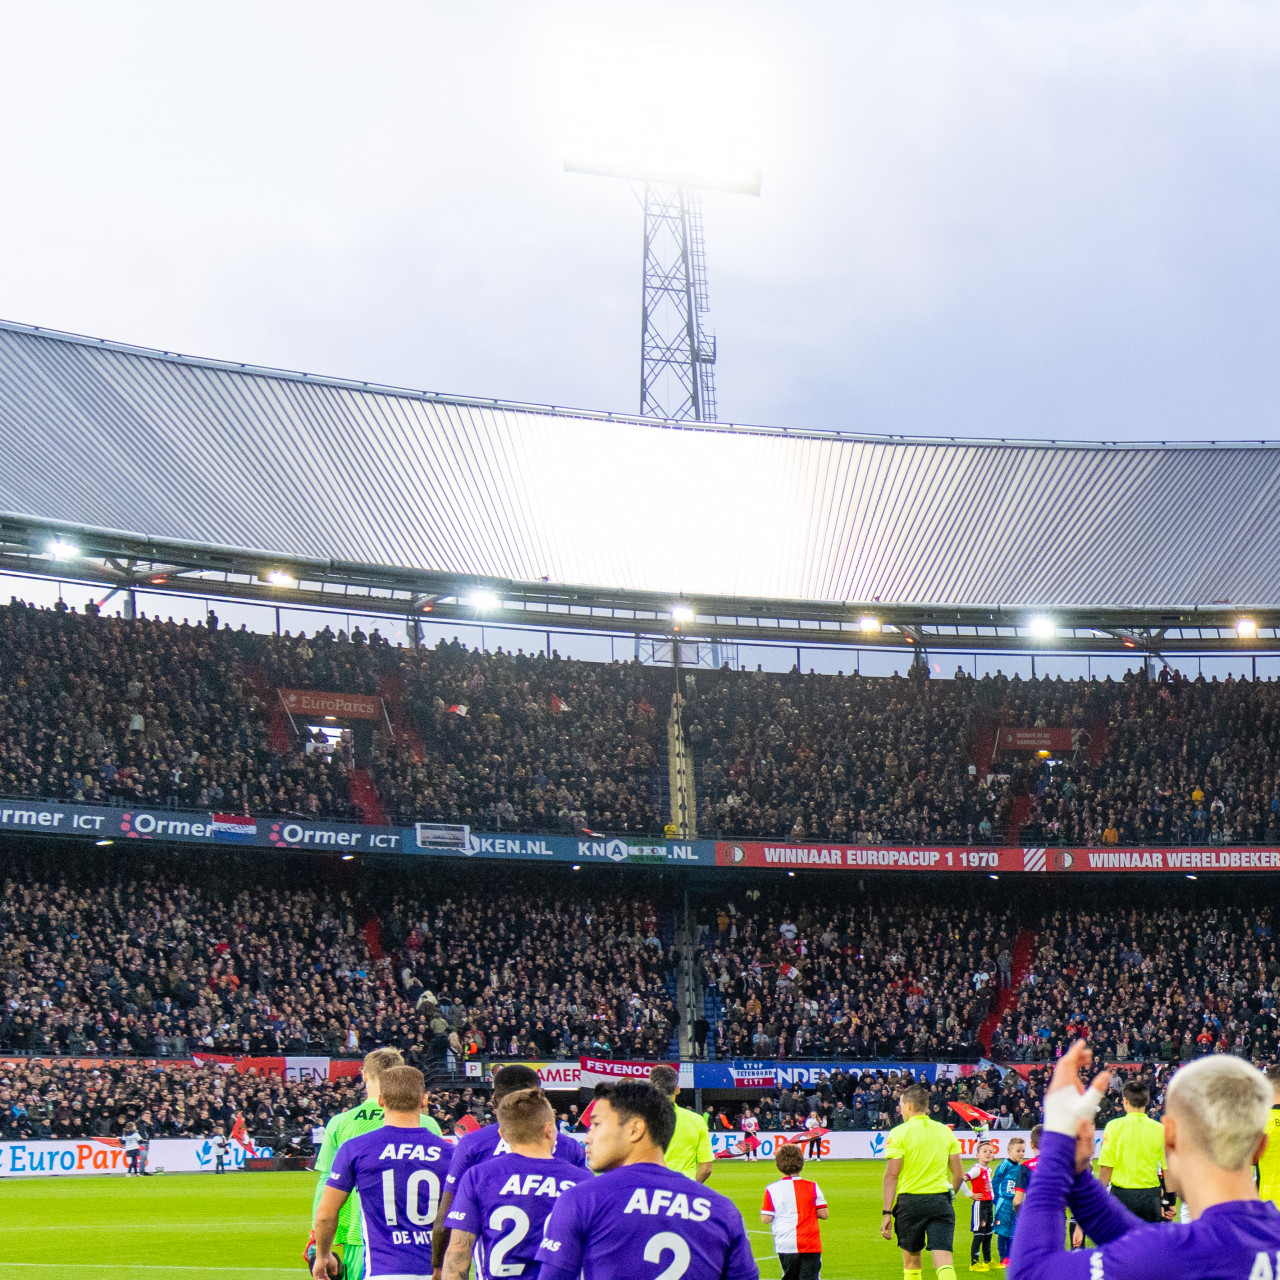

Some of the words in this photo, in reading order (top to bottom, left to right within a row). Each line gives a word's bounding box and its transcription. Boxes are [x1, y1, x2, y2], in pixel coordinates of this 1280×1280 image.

[302, 696, 374, 713] EuroParcs
[0, 809, 63, 826] rmer
[73, 815, 105, 830] ICT
[134, 814, 213, 837] Ormer
[283, 824, 361, 846] Ormer
[369, 834, 400, 848] ICT
[481, 838, 553, 856] KEN.NL
[578, 841, 699, 860] KNA.NL
[764, 847, 842, 865] WINNAAR
[847, 849, 940, 866] EUROPACUP
[945, 852, 953, 866] 1
[959, 852, 999, 867] 1970
[1089, 853, 1163, 868] WINNAAR
[1167, 852, 1280, 868] WERELDBEKER
[470, 1065, 478, 1074] P
[586, 1060, 651, 1076] FEYENOO
[10, 1144, 149, 1172] EuroPar
[379, 1143, 441, 1162] AFAS
[500, 1174, 577, 1198] AFAS
[382, 1168, 440, 1226] 10
[624, 1188, 711, 1222] AFAS
[392, 1231, 411, 1244] DE
